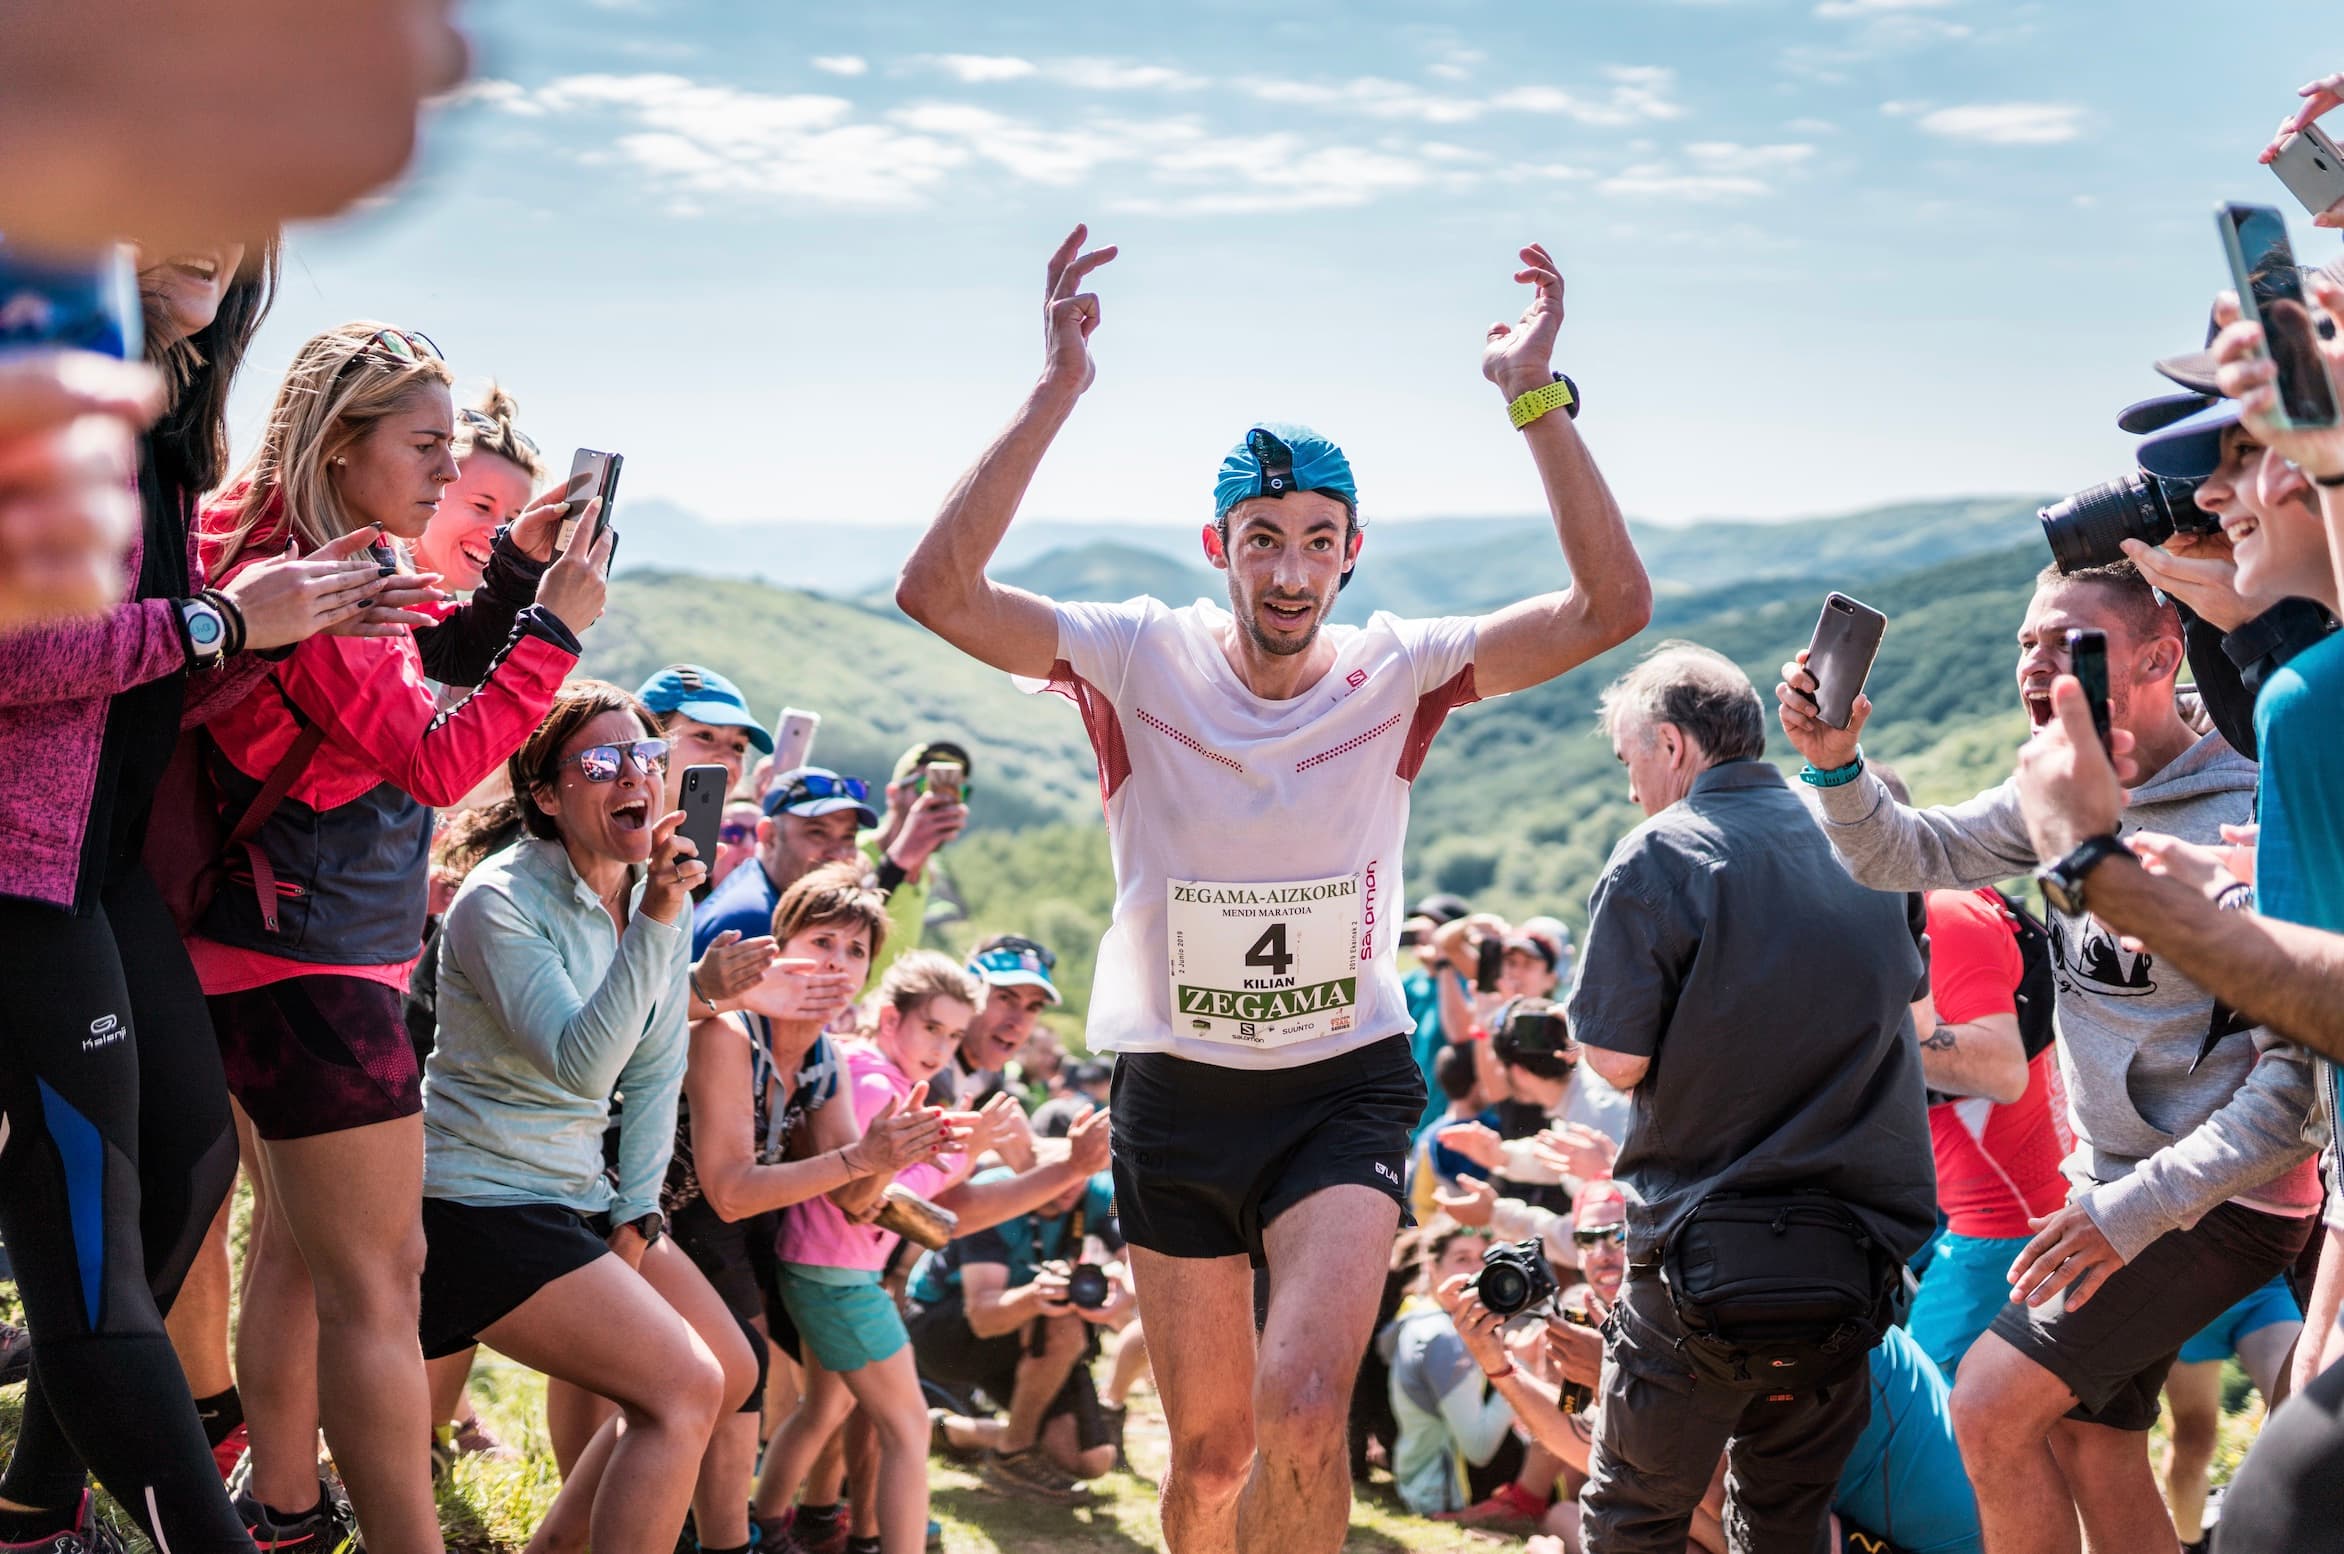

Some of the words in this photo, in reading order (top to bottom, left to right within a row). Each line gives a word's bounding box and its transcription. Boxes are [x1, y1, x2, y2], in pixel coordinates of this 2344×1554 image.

[1174, 880, 1357, 904] ZEGAMA-AIZKORRI
[1222, 909, 1256, 917] MENDI
[1259, 906, 1312, 917] MARATOIA
[1245, 923, 1293, 975] 4
[1243, 976, 1295, 989] KILIAN
[1185, 982, 1350, 1020] ZEGAMA
[1282, 1023, 1315, 1035] SUUNTO
